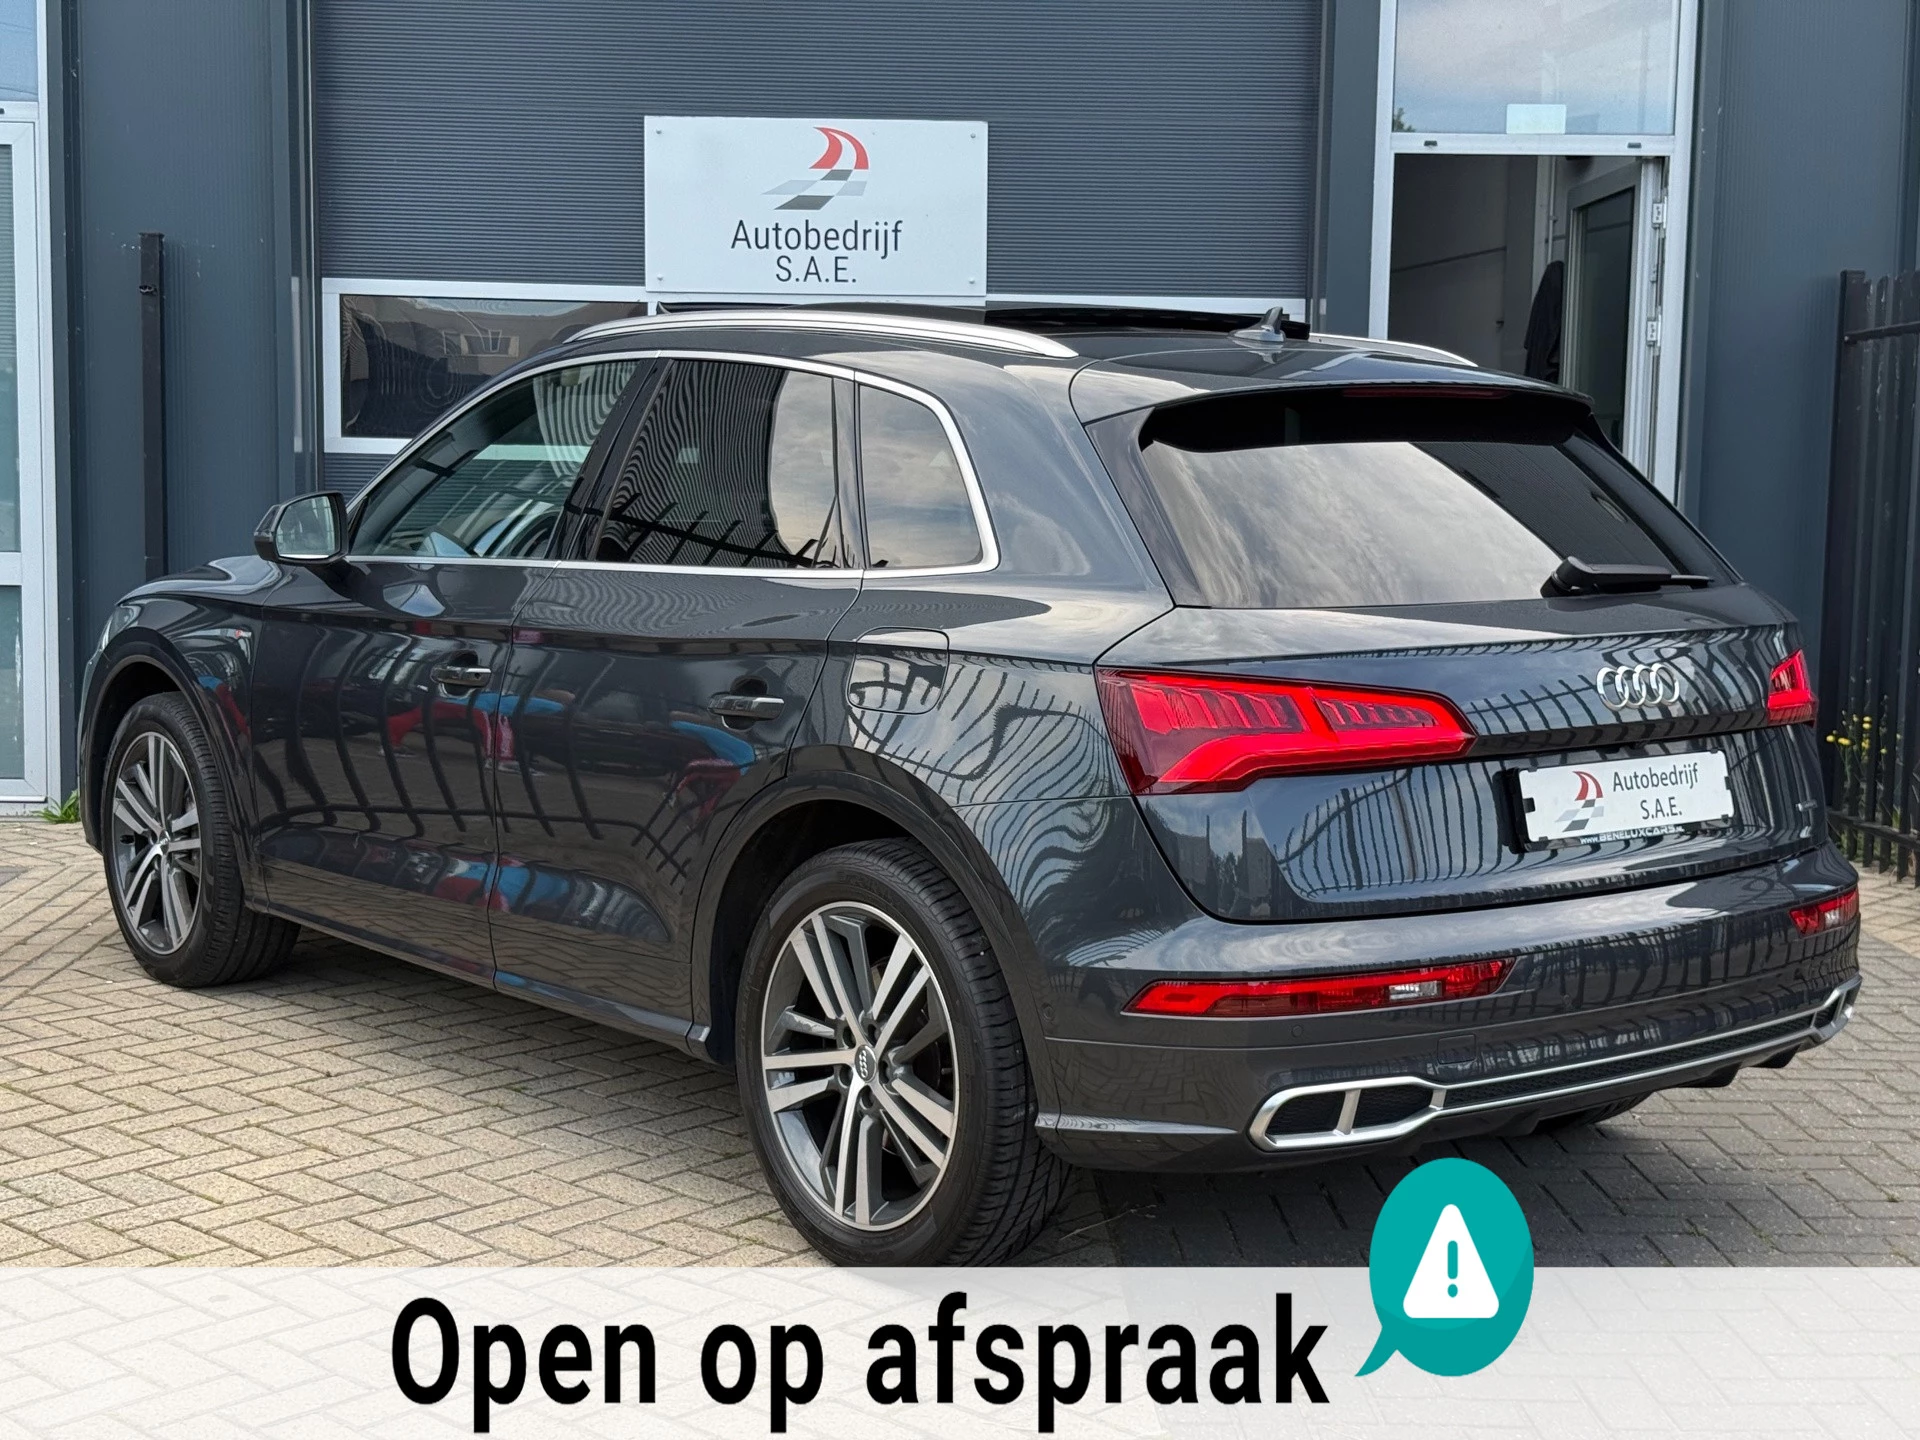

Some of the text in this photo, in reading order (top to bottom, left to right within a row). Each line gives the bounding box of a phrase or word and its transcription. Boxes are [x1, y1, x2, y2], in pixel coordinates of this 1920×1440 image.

[731, 219, 903, 260] Autobedrijf
[775, 254, 857, 283] S.A.E.
[1612, 763, 1699, 790] Autobedrijf
[1640, 796, 1683, 820] S.A.E.
